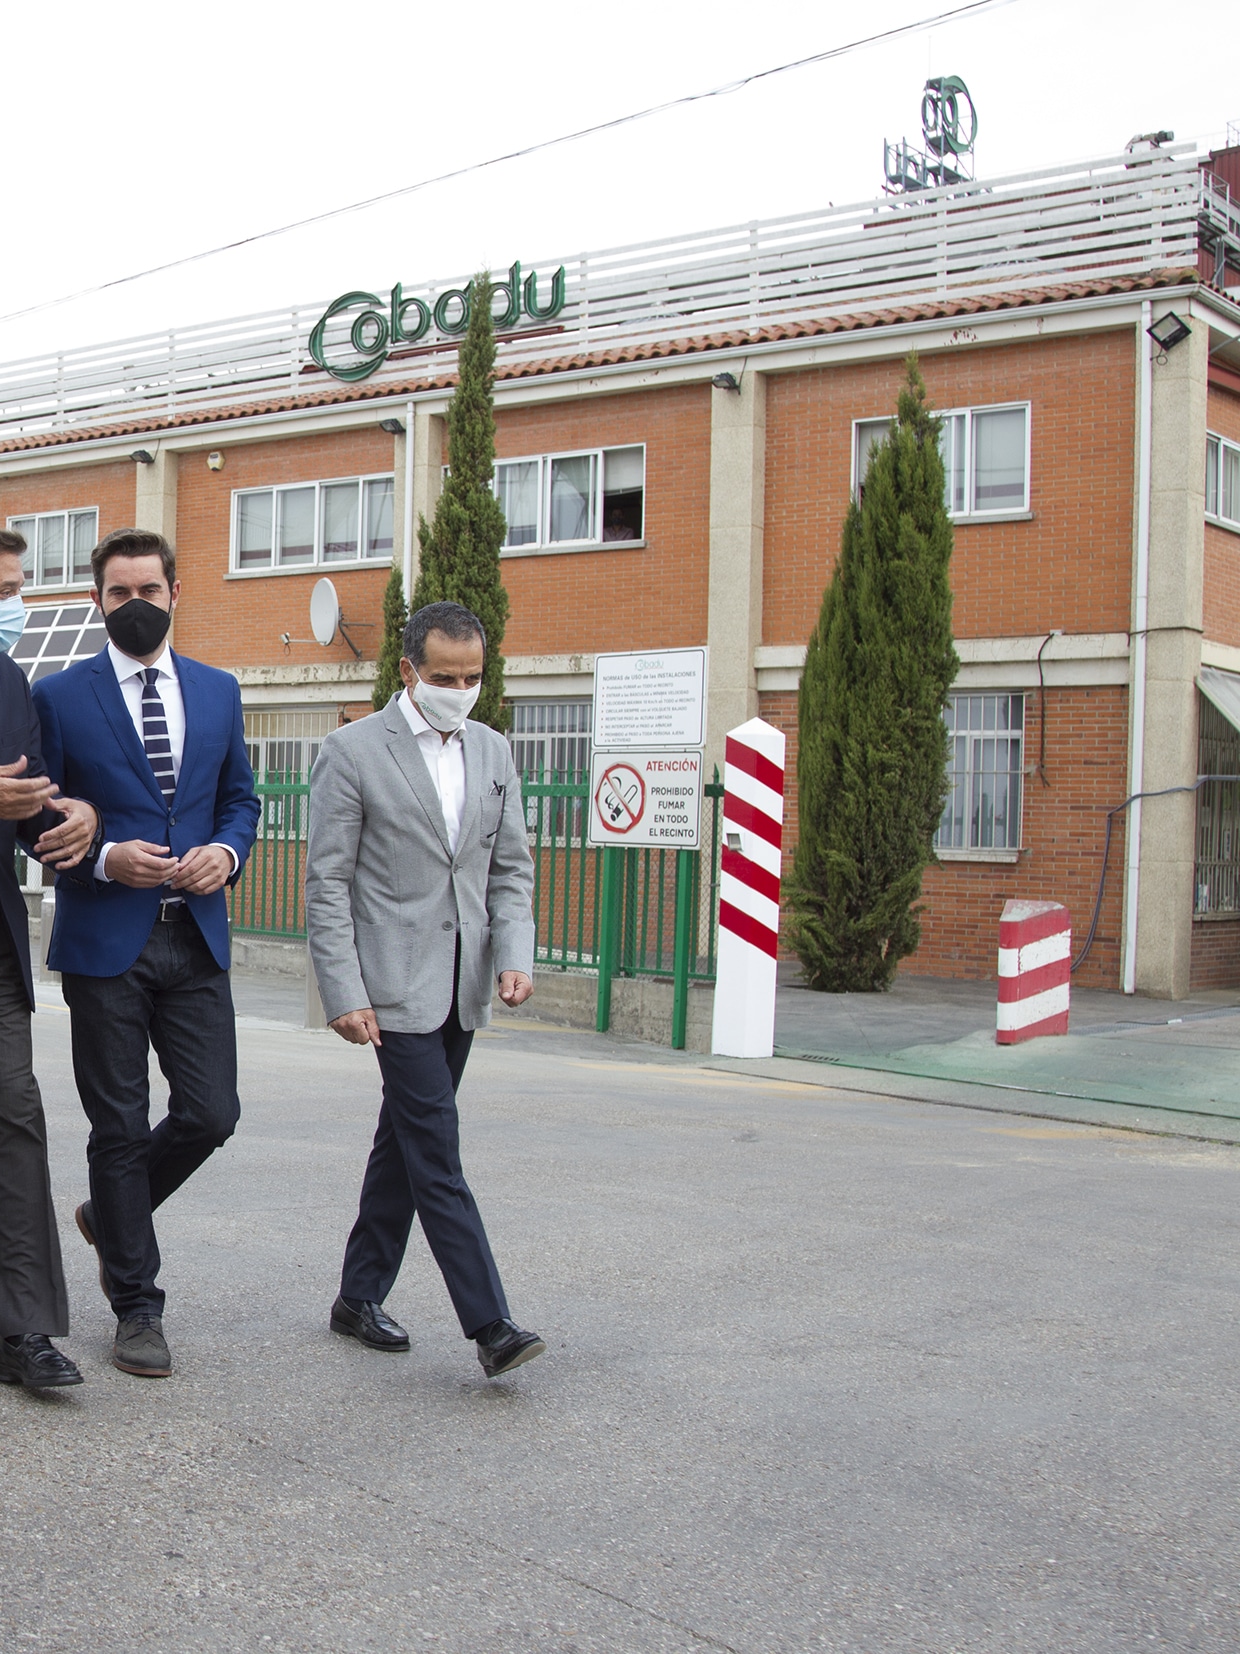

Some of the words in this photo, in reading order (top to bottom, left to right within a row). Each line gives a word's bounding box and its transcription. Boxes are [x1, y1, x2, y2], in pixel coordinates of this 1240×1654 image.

[309, 260, 565, 382] Cobadu
[646, 758, 697, 771] ATENCIÓN
[651, 787, 693, 796] PROHIBIDO
[658, 801, 685, 809] FUMAR
[654, 815, 664, 823] EN
[667, 815, 688, 823] TODO
[649, 828, 658, 836] EL
[660, 829, 694, 837] RECINTO
